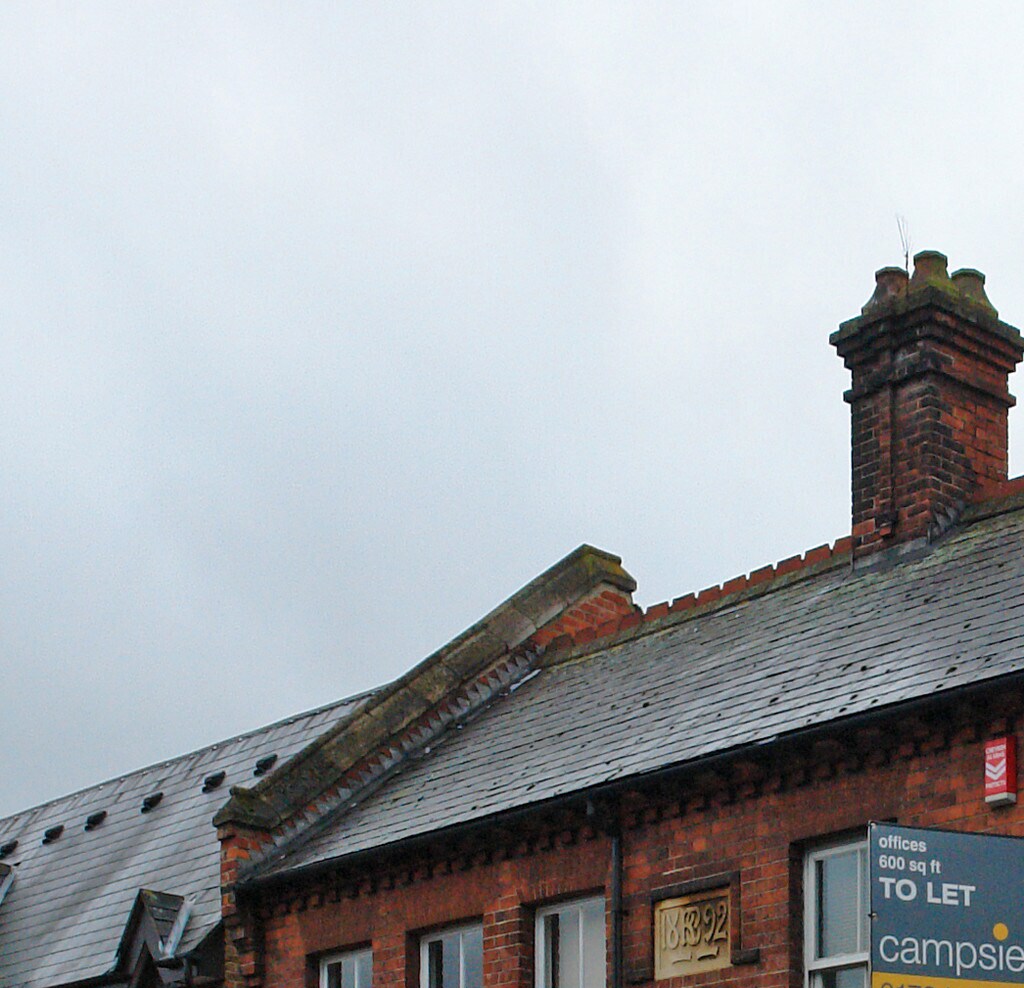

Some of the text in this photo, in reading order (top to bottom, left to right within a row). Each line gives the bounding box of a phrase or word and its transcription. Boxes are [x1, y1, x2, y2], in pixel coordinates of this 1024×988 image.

[879, 835, 927, 852] offices
[879, 855, 941, 876] 600 sq ft
[879, 877, 976, 907] TO LET
